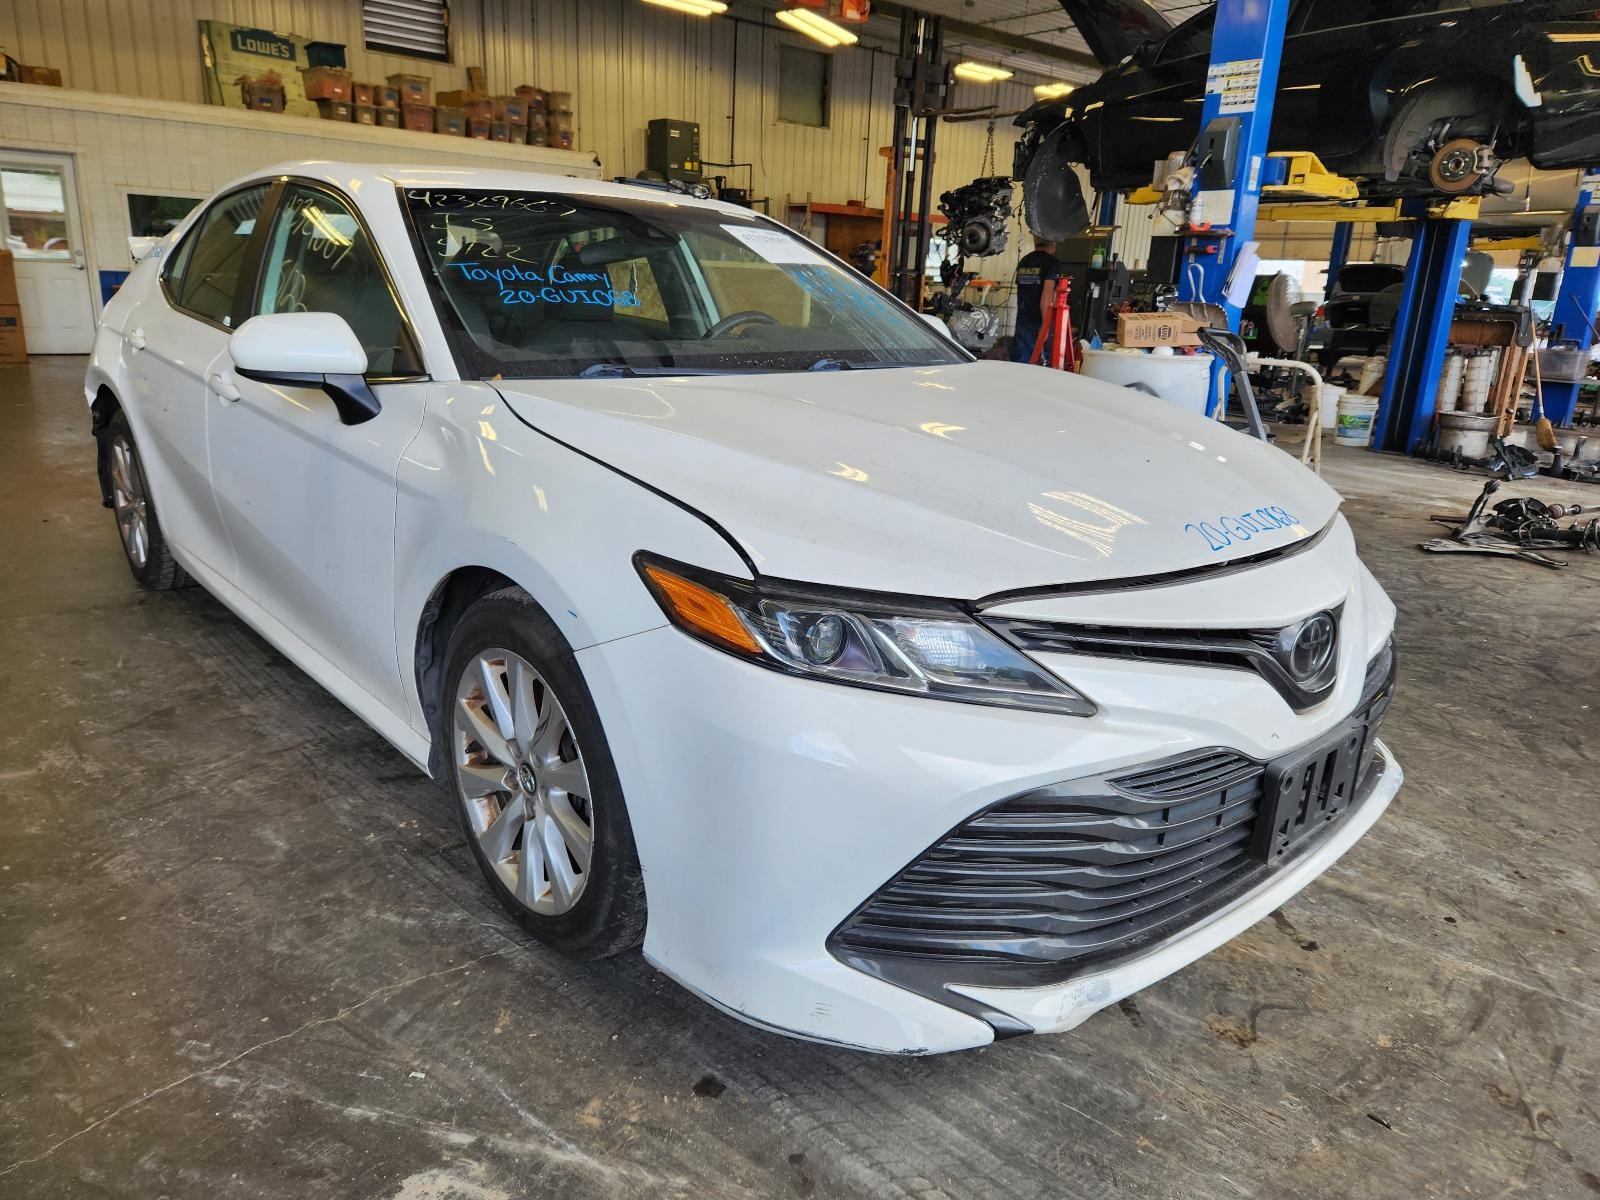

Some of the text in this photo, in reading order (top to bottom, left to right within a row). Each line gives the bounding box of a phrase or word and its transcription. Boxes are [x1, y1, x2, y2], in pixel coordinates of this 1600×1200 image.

[236, 33, 291, 58] LOWE'S
[447, 262, 613, 291] Toyota Camry
